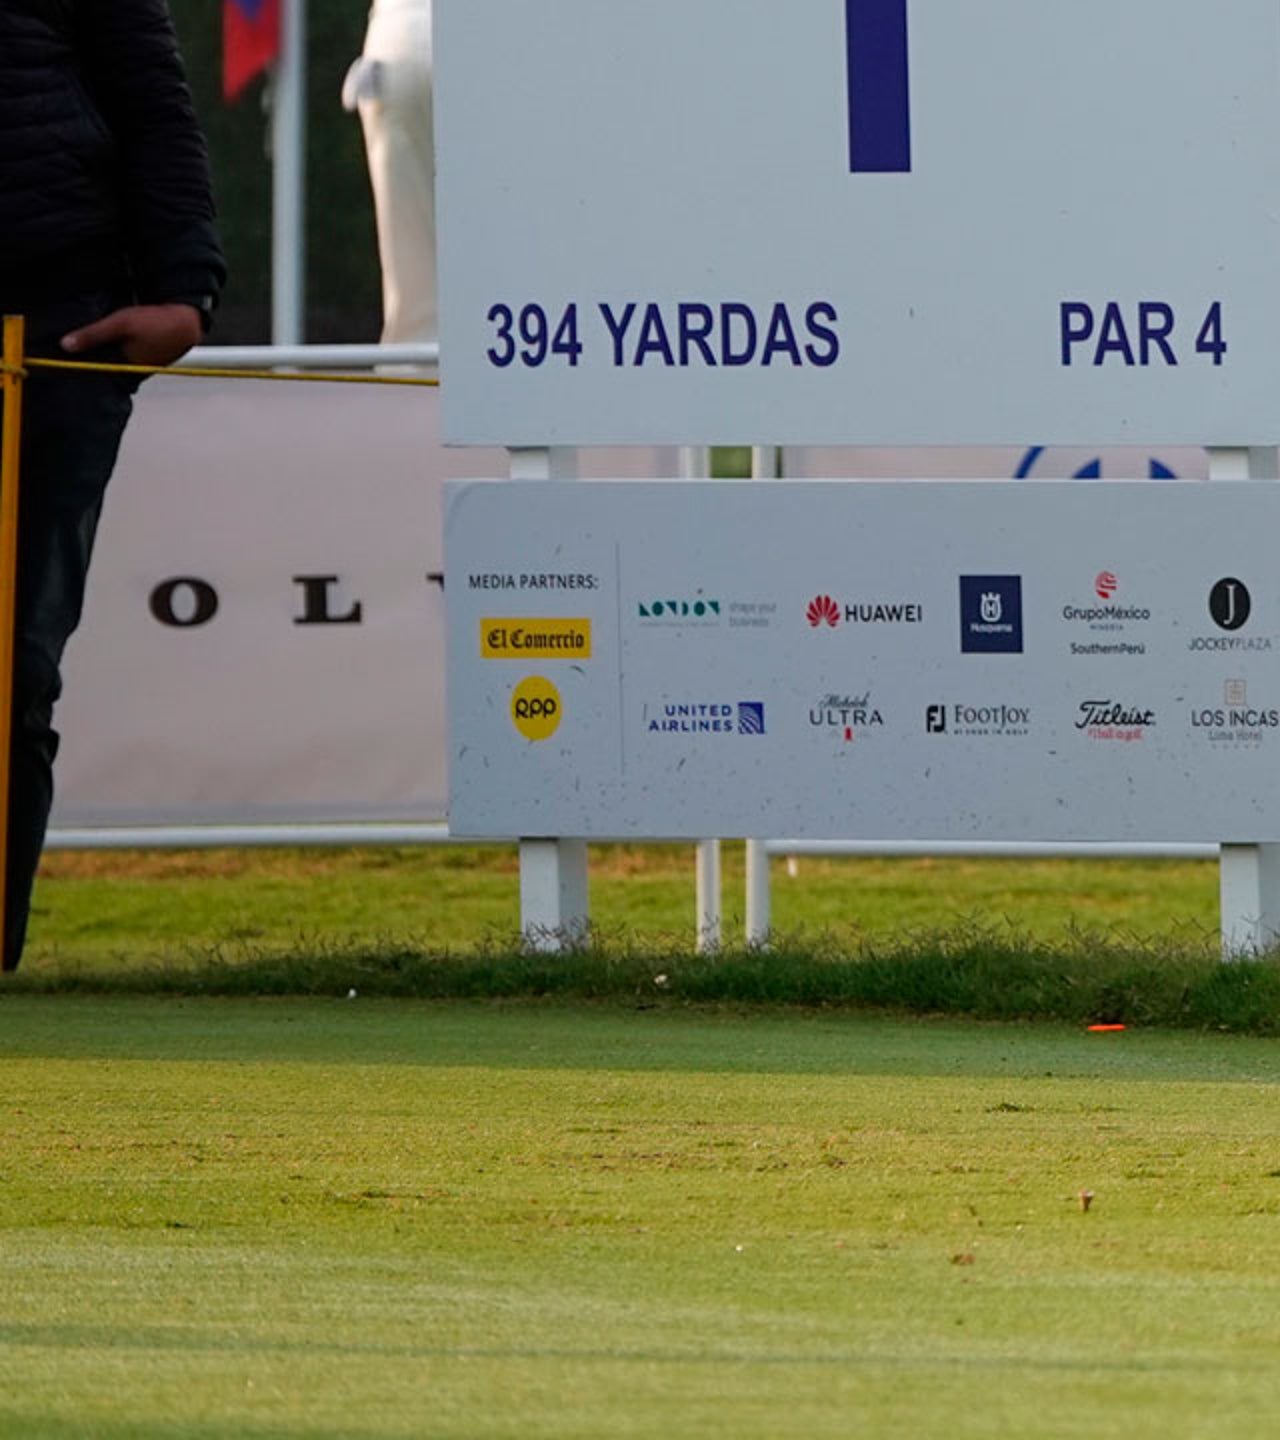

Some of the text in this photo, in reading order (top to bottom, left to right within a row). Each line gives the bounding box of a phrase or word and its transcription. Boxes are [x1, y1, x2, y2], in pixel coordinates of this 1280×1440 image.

[487, 301, 840, 366] 394 YARDAS
[1060, 301, 1227, 365] PAR 4
[468, 574, 599, 590] MEDIA PARTNERS:
[845, 604, 922, 623] HUAWEI
[487, 628, 585, 649] El Comercio
[665, 704, 733, 717] UNITED
[809, 709, 884, 726] ULTRA
[1075, 700, 1156, 729] Titleist
[1191, 710, 1279, 727] LOS INCAS
[648, 719, 733, 732] AIRLINES
